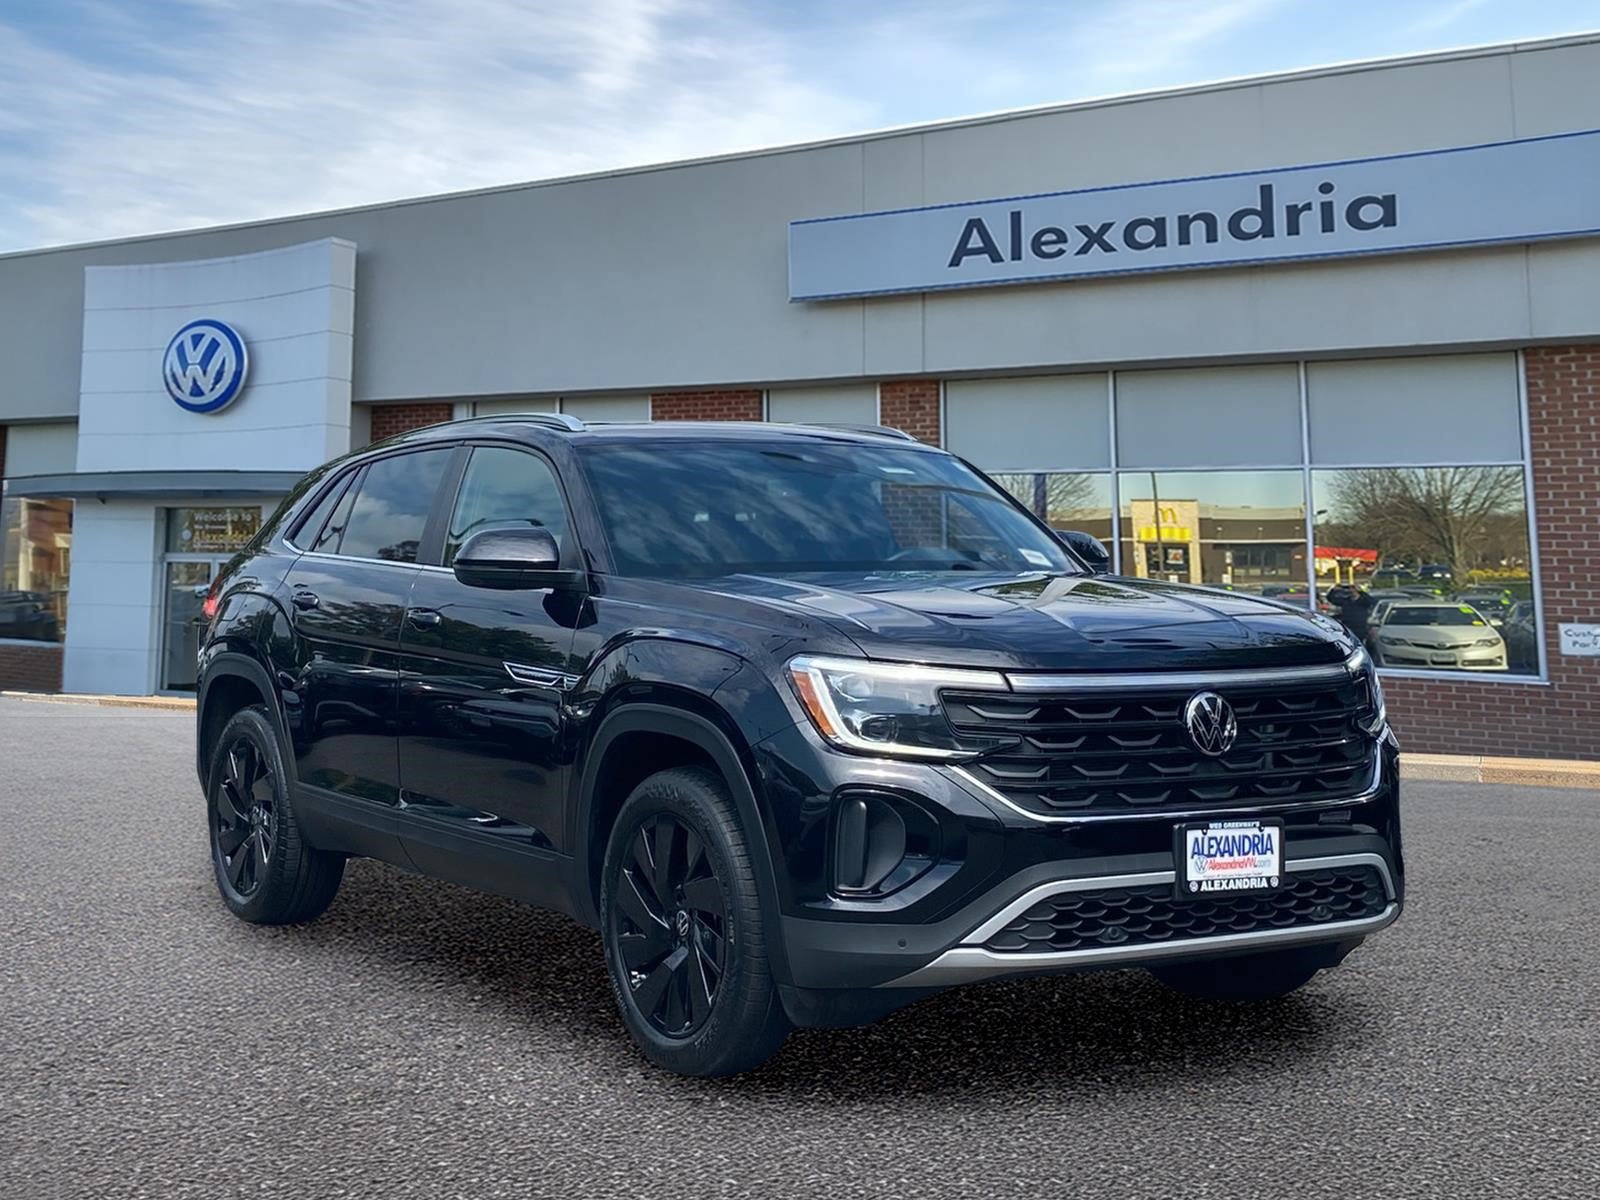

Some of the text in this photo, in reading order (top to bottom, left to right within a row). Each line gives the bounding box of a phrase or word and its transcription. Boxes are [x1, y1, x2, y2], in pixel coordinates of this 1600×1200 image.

[947, 182, 1398, 268] Alexandria
[165, 321, 242, 408] VW
[1191, 833, 1274, 859] ALEXANDRIA
[1200, 877, 1268, 892] ALEXANDRIA
